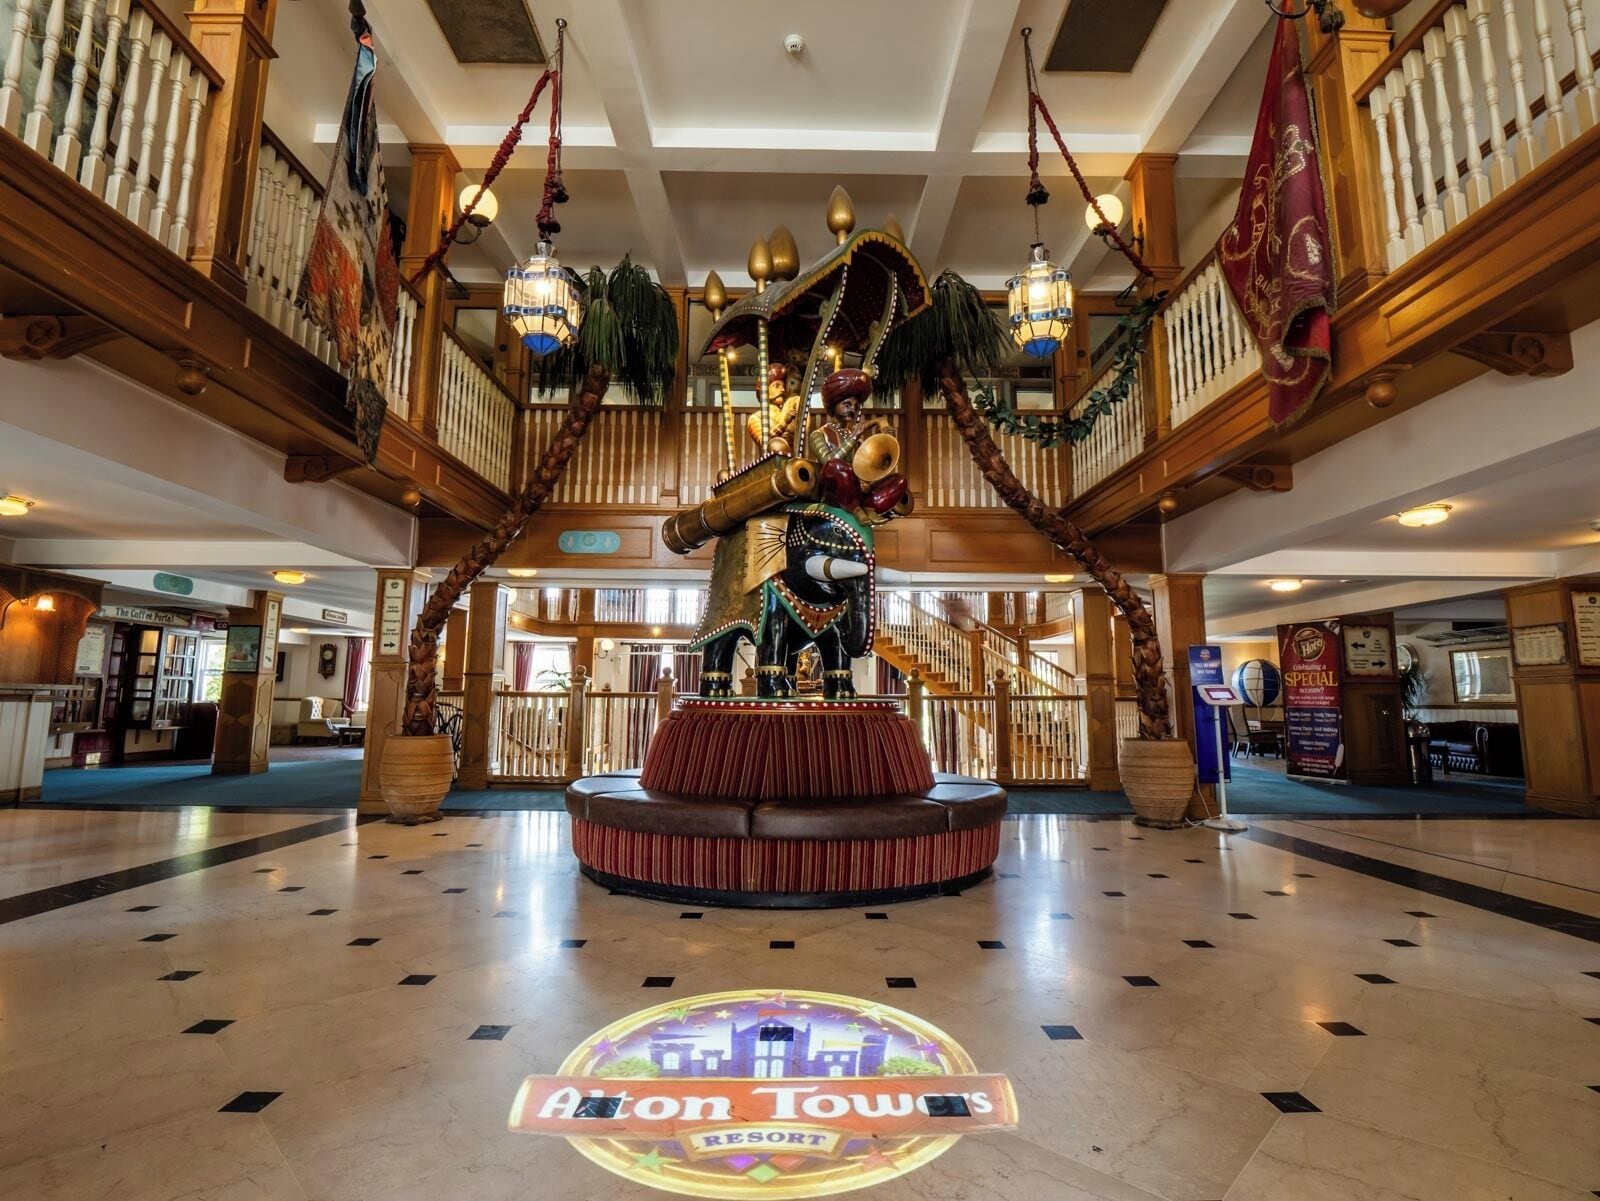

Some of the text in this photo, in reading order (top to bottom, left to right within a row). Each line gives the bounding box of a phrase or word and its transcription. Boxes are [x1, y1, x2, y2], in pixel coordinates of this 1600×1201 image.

[116, 607, 174, 623] The Coffee Portal
[1284, 671, 1339, 687] SPECIAL
[702, 1131, 827, 1148] RESORT
